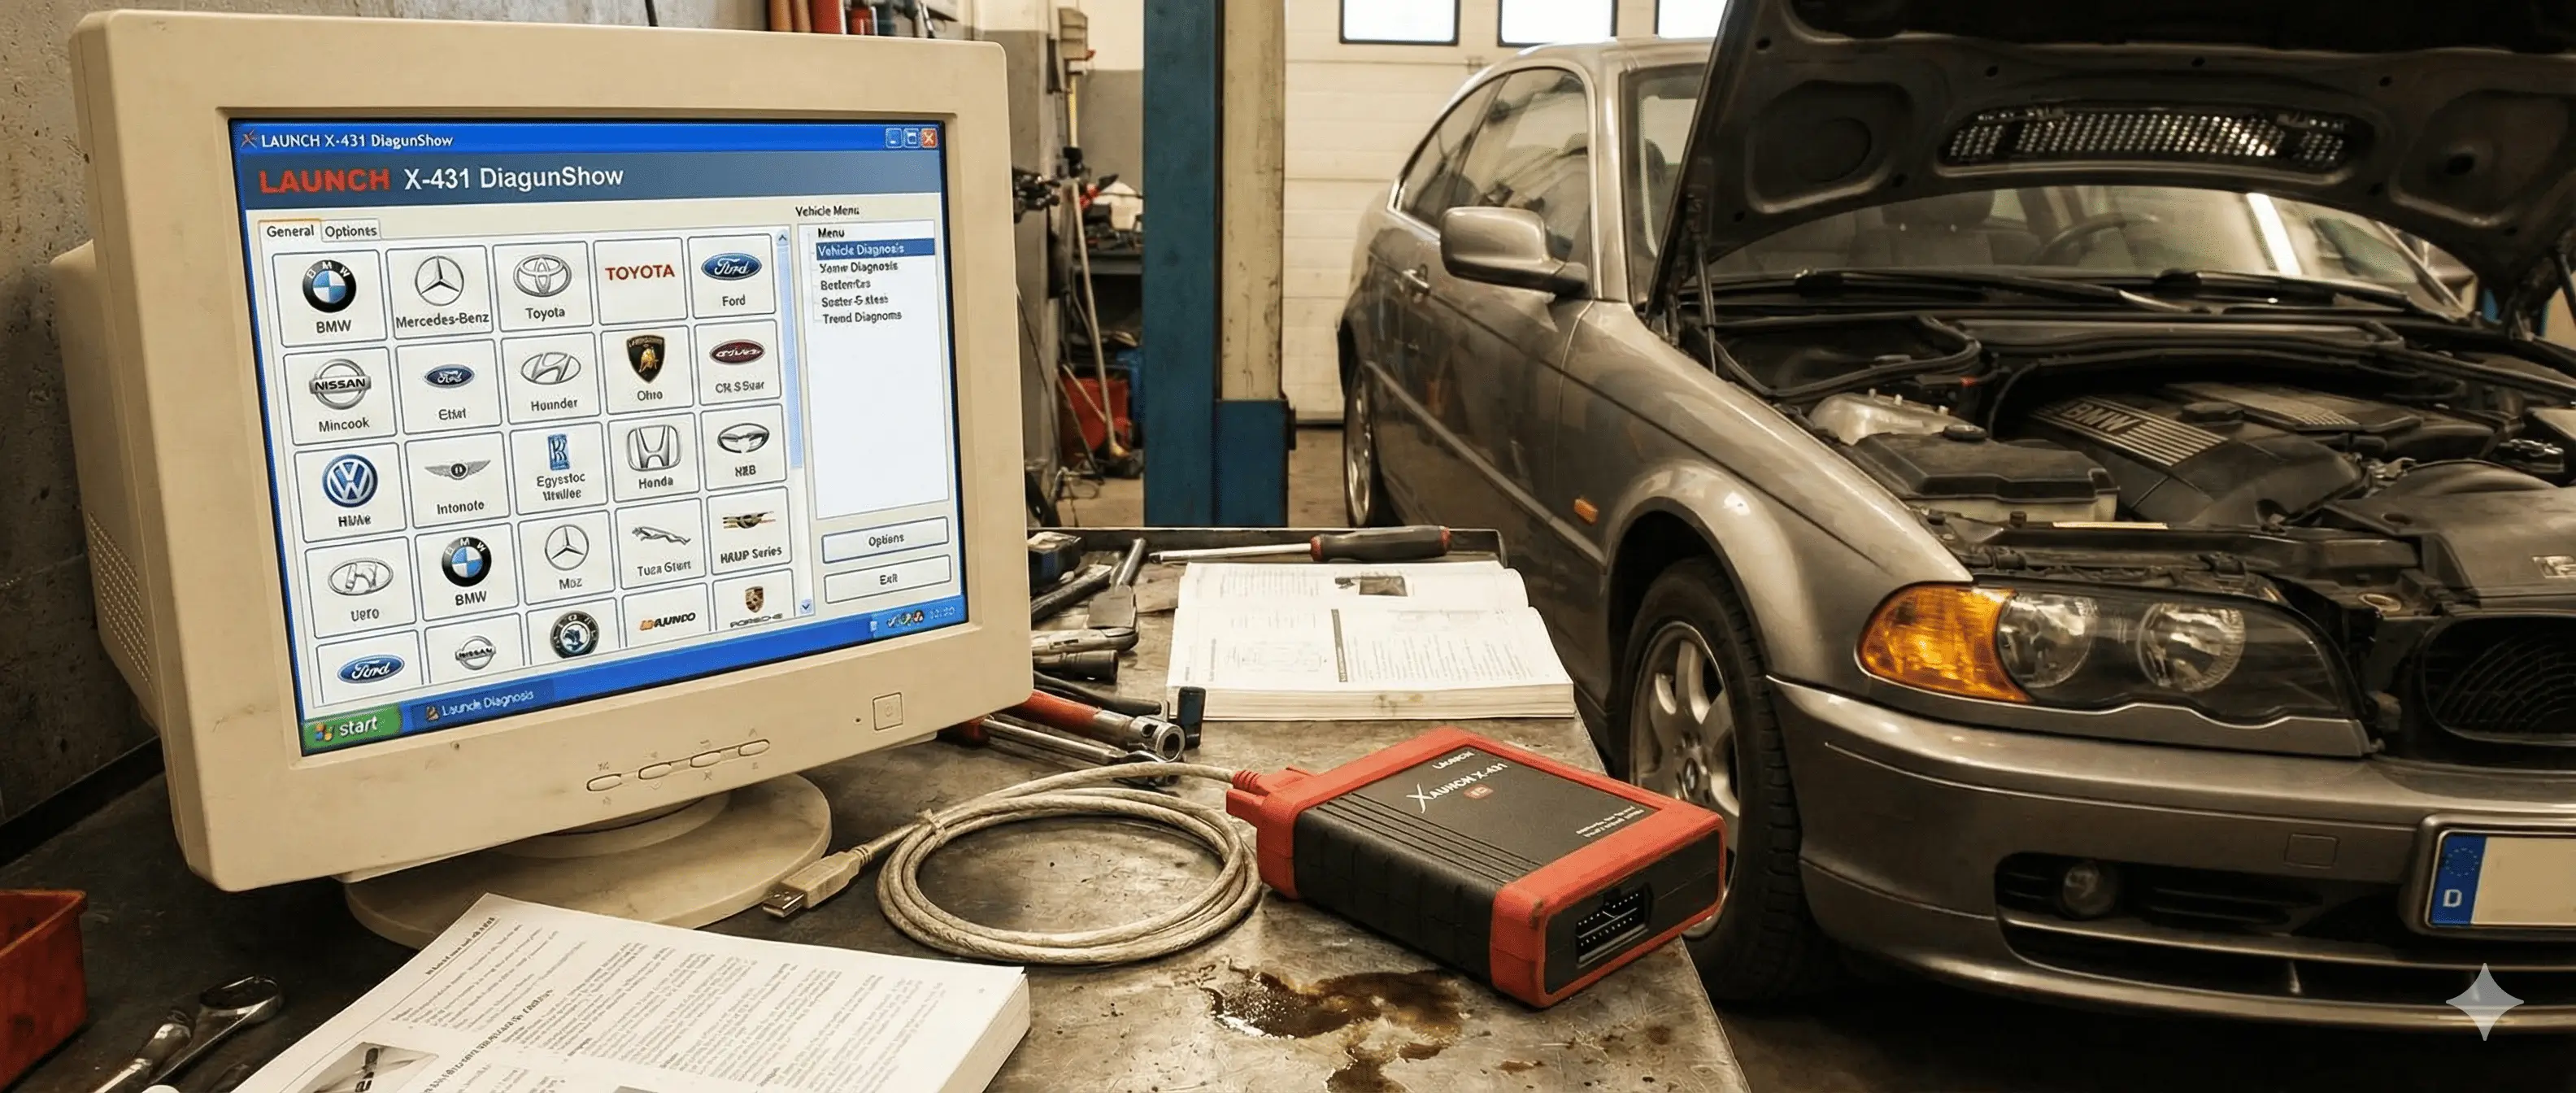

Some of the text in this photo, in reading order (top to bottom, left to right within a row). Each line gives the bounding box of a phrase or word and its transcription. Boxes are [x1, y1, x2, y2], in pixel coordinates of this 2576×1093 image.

[261, 134, 320, 148] LAUNCH
[371, 133, 454, 150] DiagunShow
[258, 166, 624, 194] LAUNCH X-431 DiagunShow
[266, 224, 315, 237] General
[817, 227, 845, 238] Menu
[605, 263, 676, 281] TOYOTA
[721, 294, 746, 307] Ford
[395, 311, 490, 329] Mercedes-Benz
[525, 307, 566, 322] Toyota
[315, 320, 352, 334] BMW
[315, 377, 366, 391] NISSAN
[318, 417, 370, 433] Mincook
[2060, 403, 2143, 433] BMW
[638, 476, 674, 490] Honda
[455, 590, 488, 607] BMW
[338, 715, 379, 737] start
[2442, 889, 2463, 908] D
